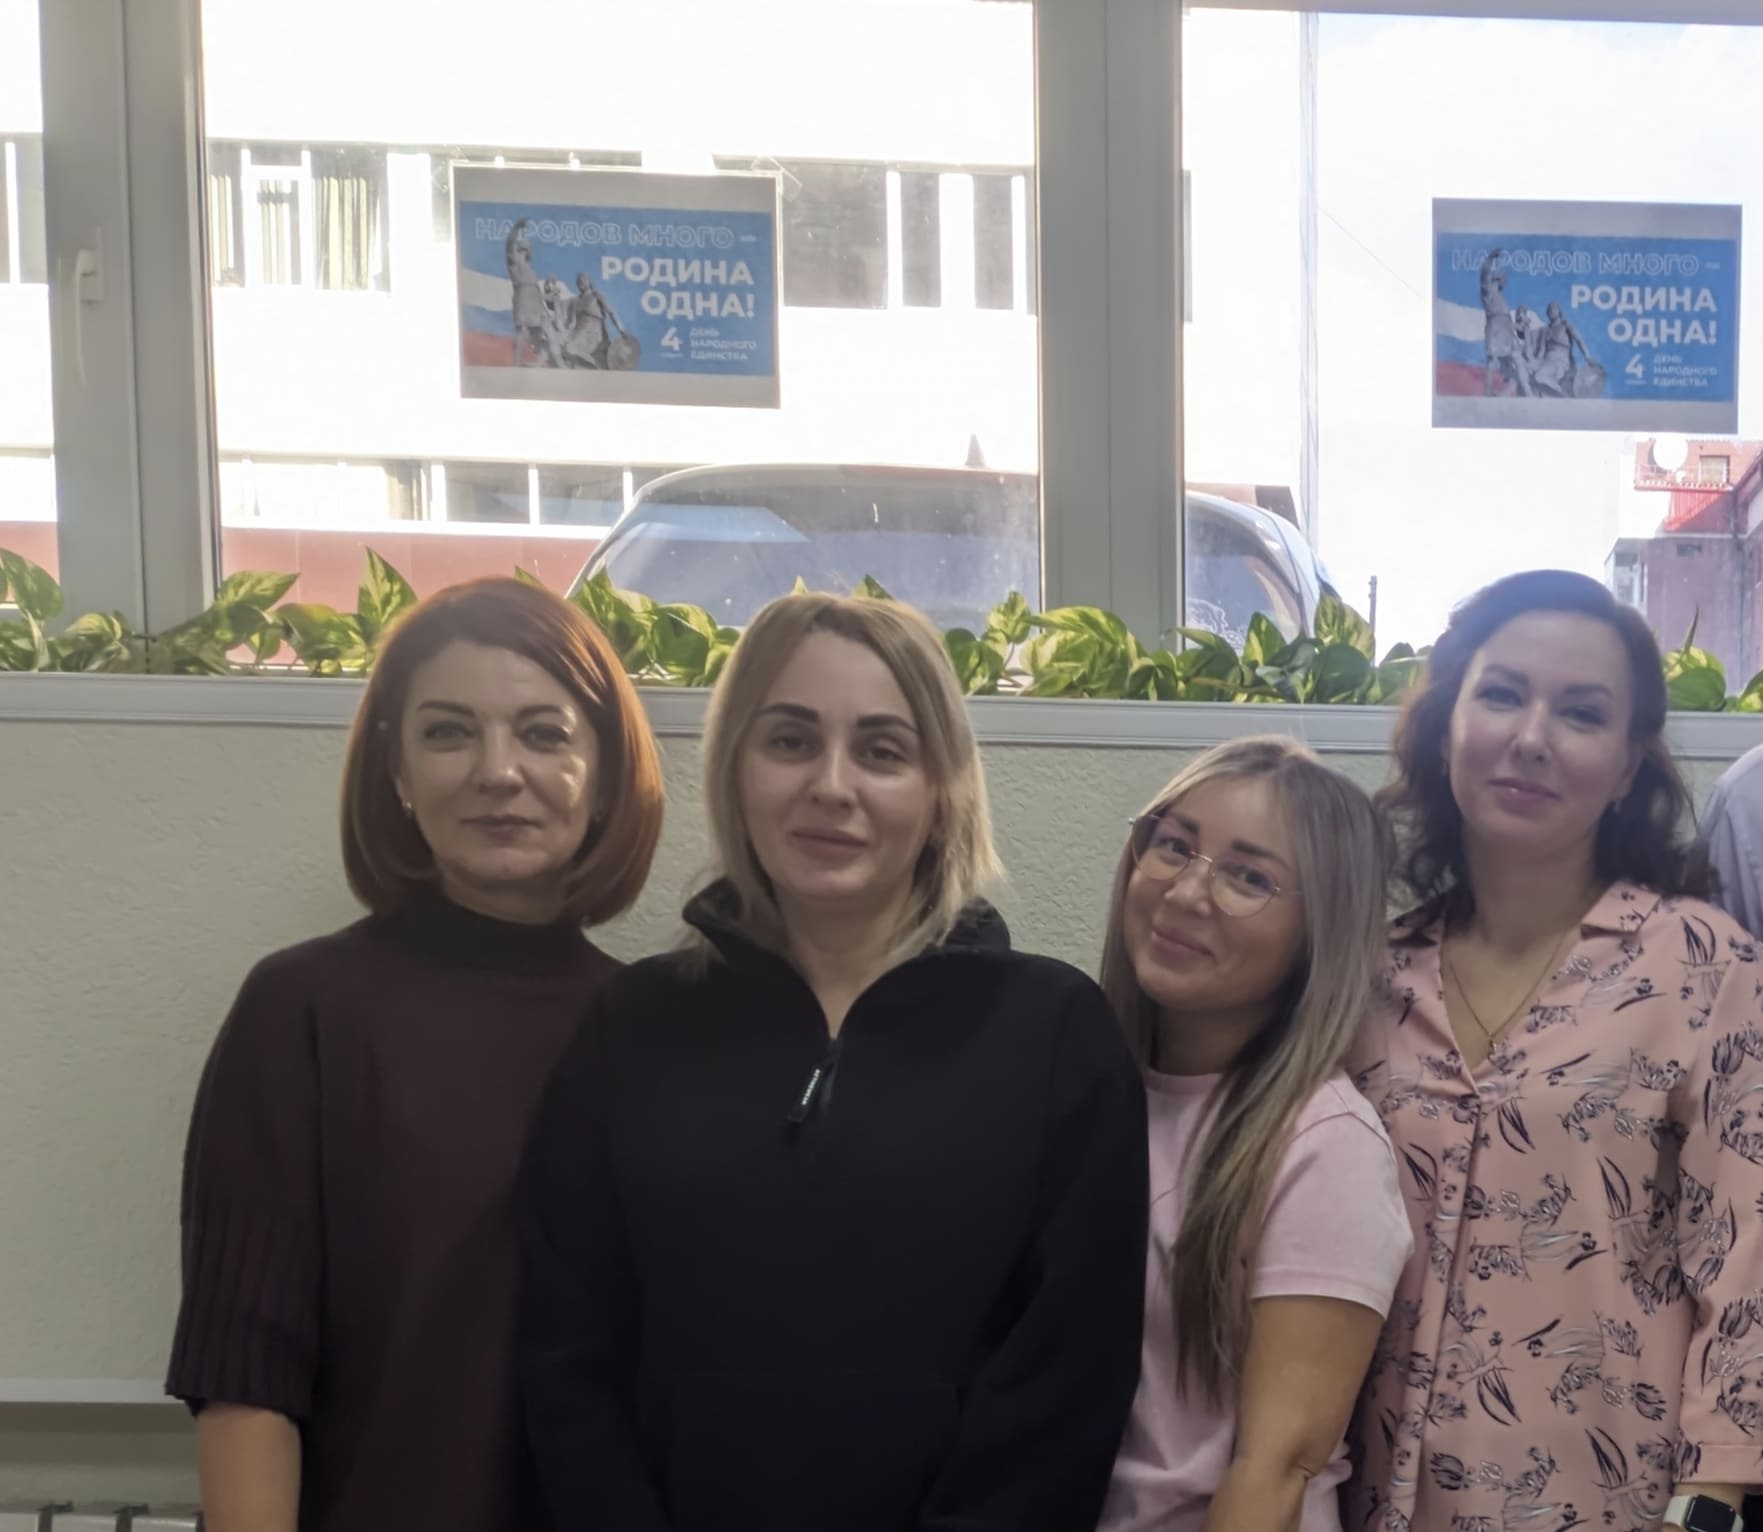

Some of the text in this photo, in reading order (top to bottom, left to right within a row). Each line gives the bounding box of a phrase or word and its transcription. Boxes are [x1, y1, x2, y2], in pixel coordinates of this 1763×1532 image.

[628, 223, 735, 249] МНОГО
[601, 255, 754, 286] РОДИНА
[1599, 252, 1700, 276] МНОГО
[641, 289, 755, 320] ОДНА!
[1570, 285, 1718, 315] РОДИНА
[660, 326, 684, 352] 4
[1607, 317, 1718, 348] ОДНА!
[1624, 353, 1645, 379] 4
